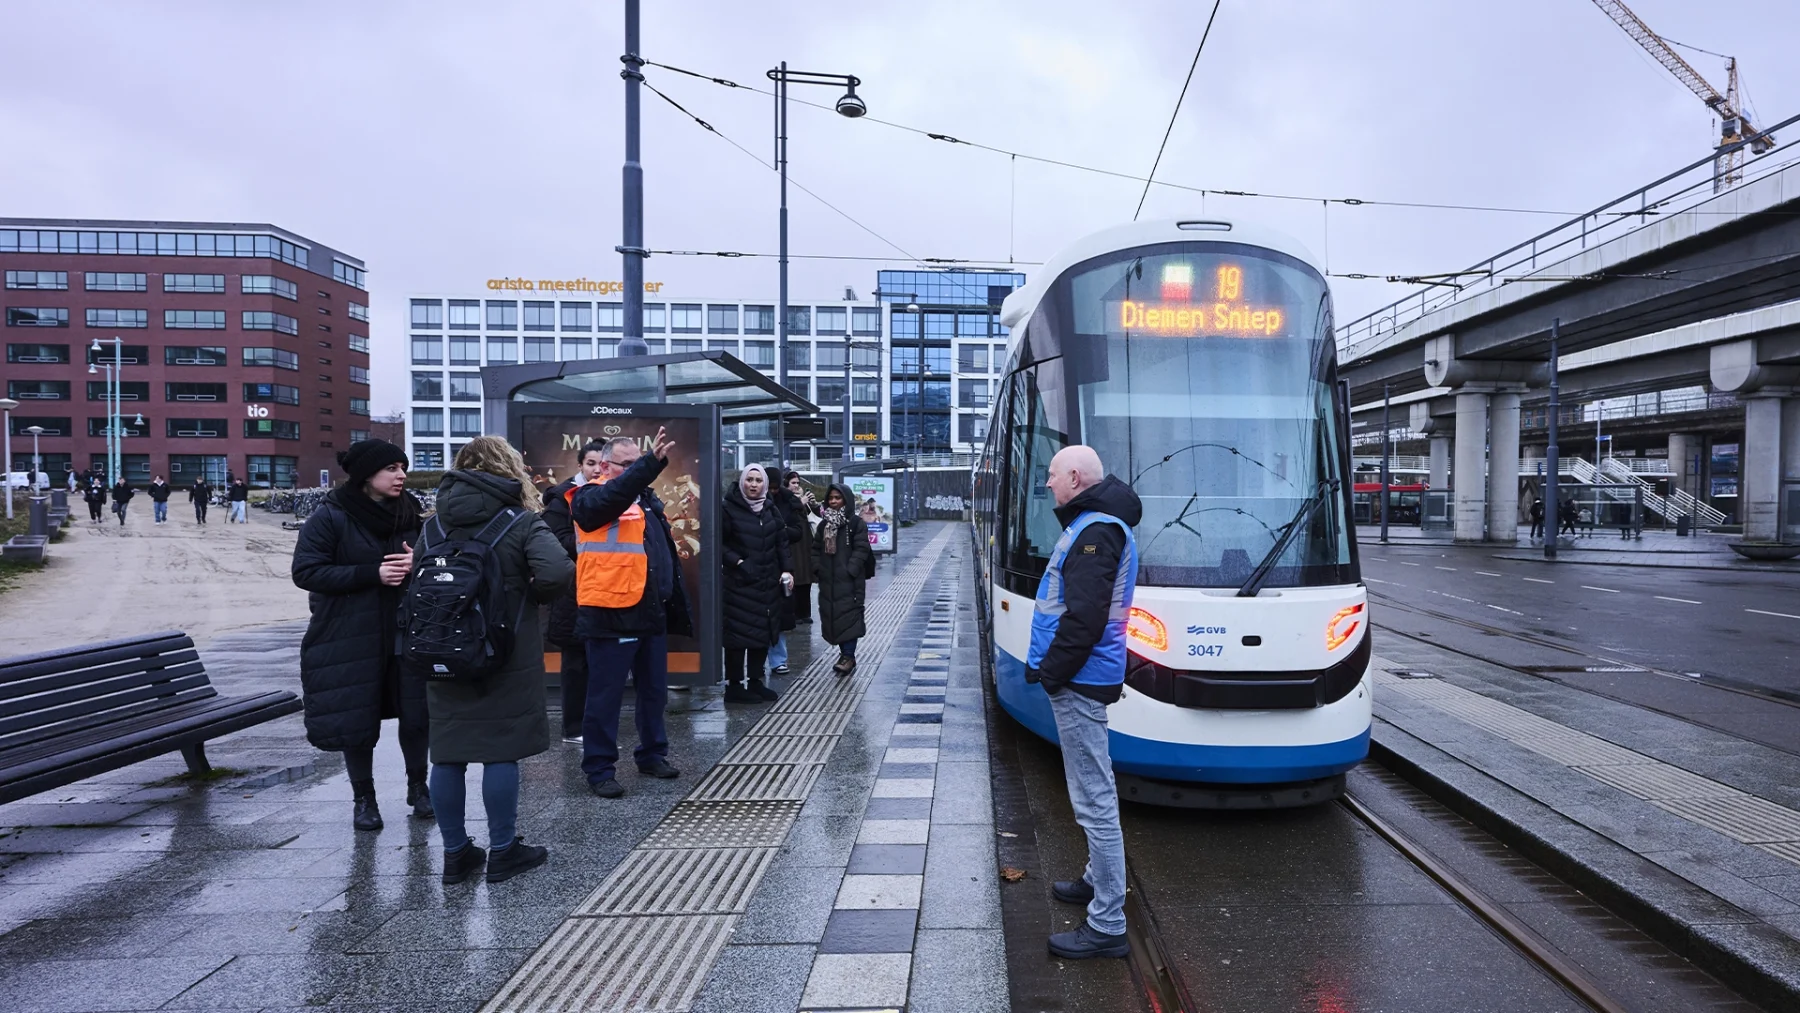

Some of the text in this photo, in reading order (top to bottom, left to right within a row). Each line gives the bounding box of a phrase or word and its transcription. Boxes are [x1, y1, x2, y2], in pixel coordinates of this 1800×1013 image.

[486, 277, 664, 295] aristo meetingceer
[1218, 266, 1240, 299] 19
[1122, 301, 1281, 335] Diemen Sniep
[247, 404, 268, 417] tio
[591, 406, 632, 415] JCDecaux
[1206, 626, 1226, 634] GVB
[1188, 645, 1223, 656] 3047
